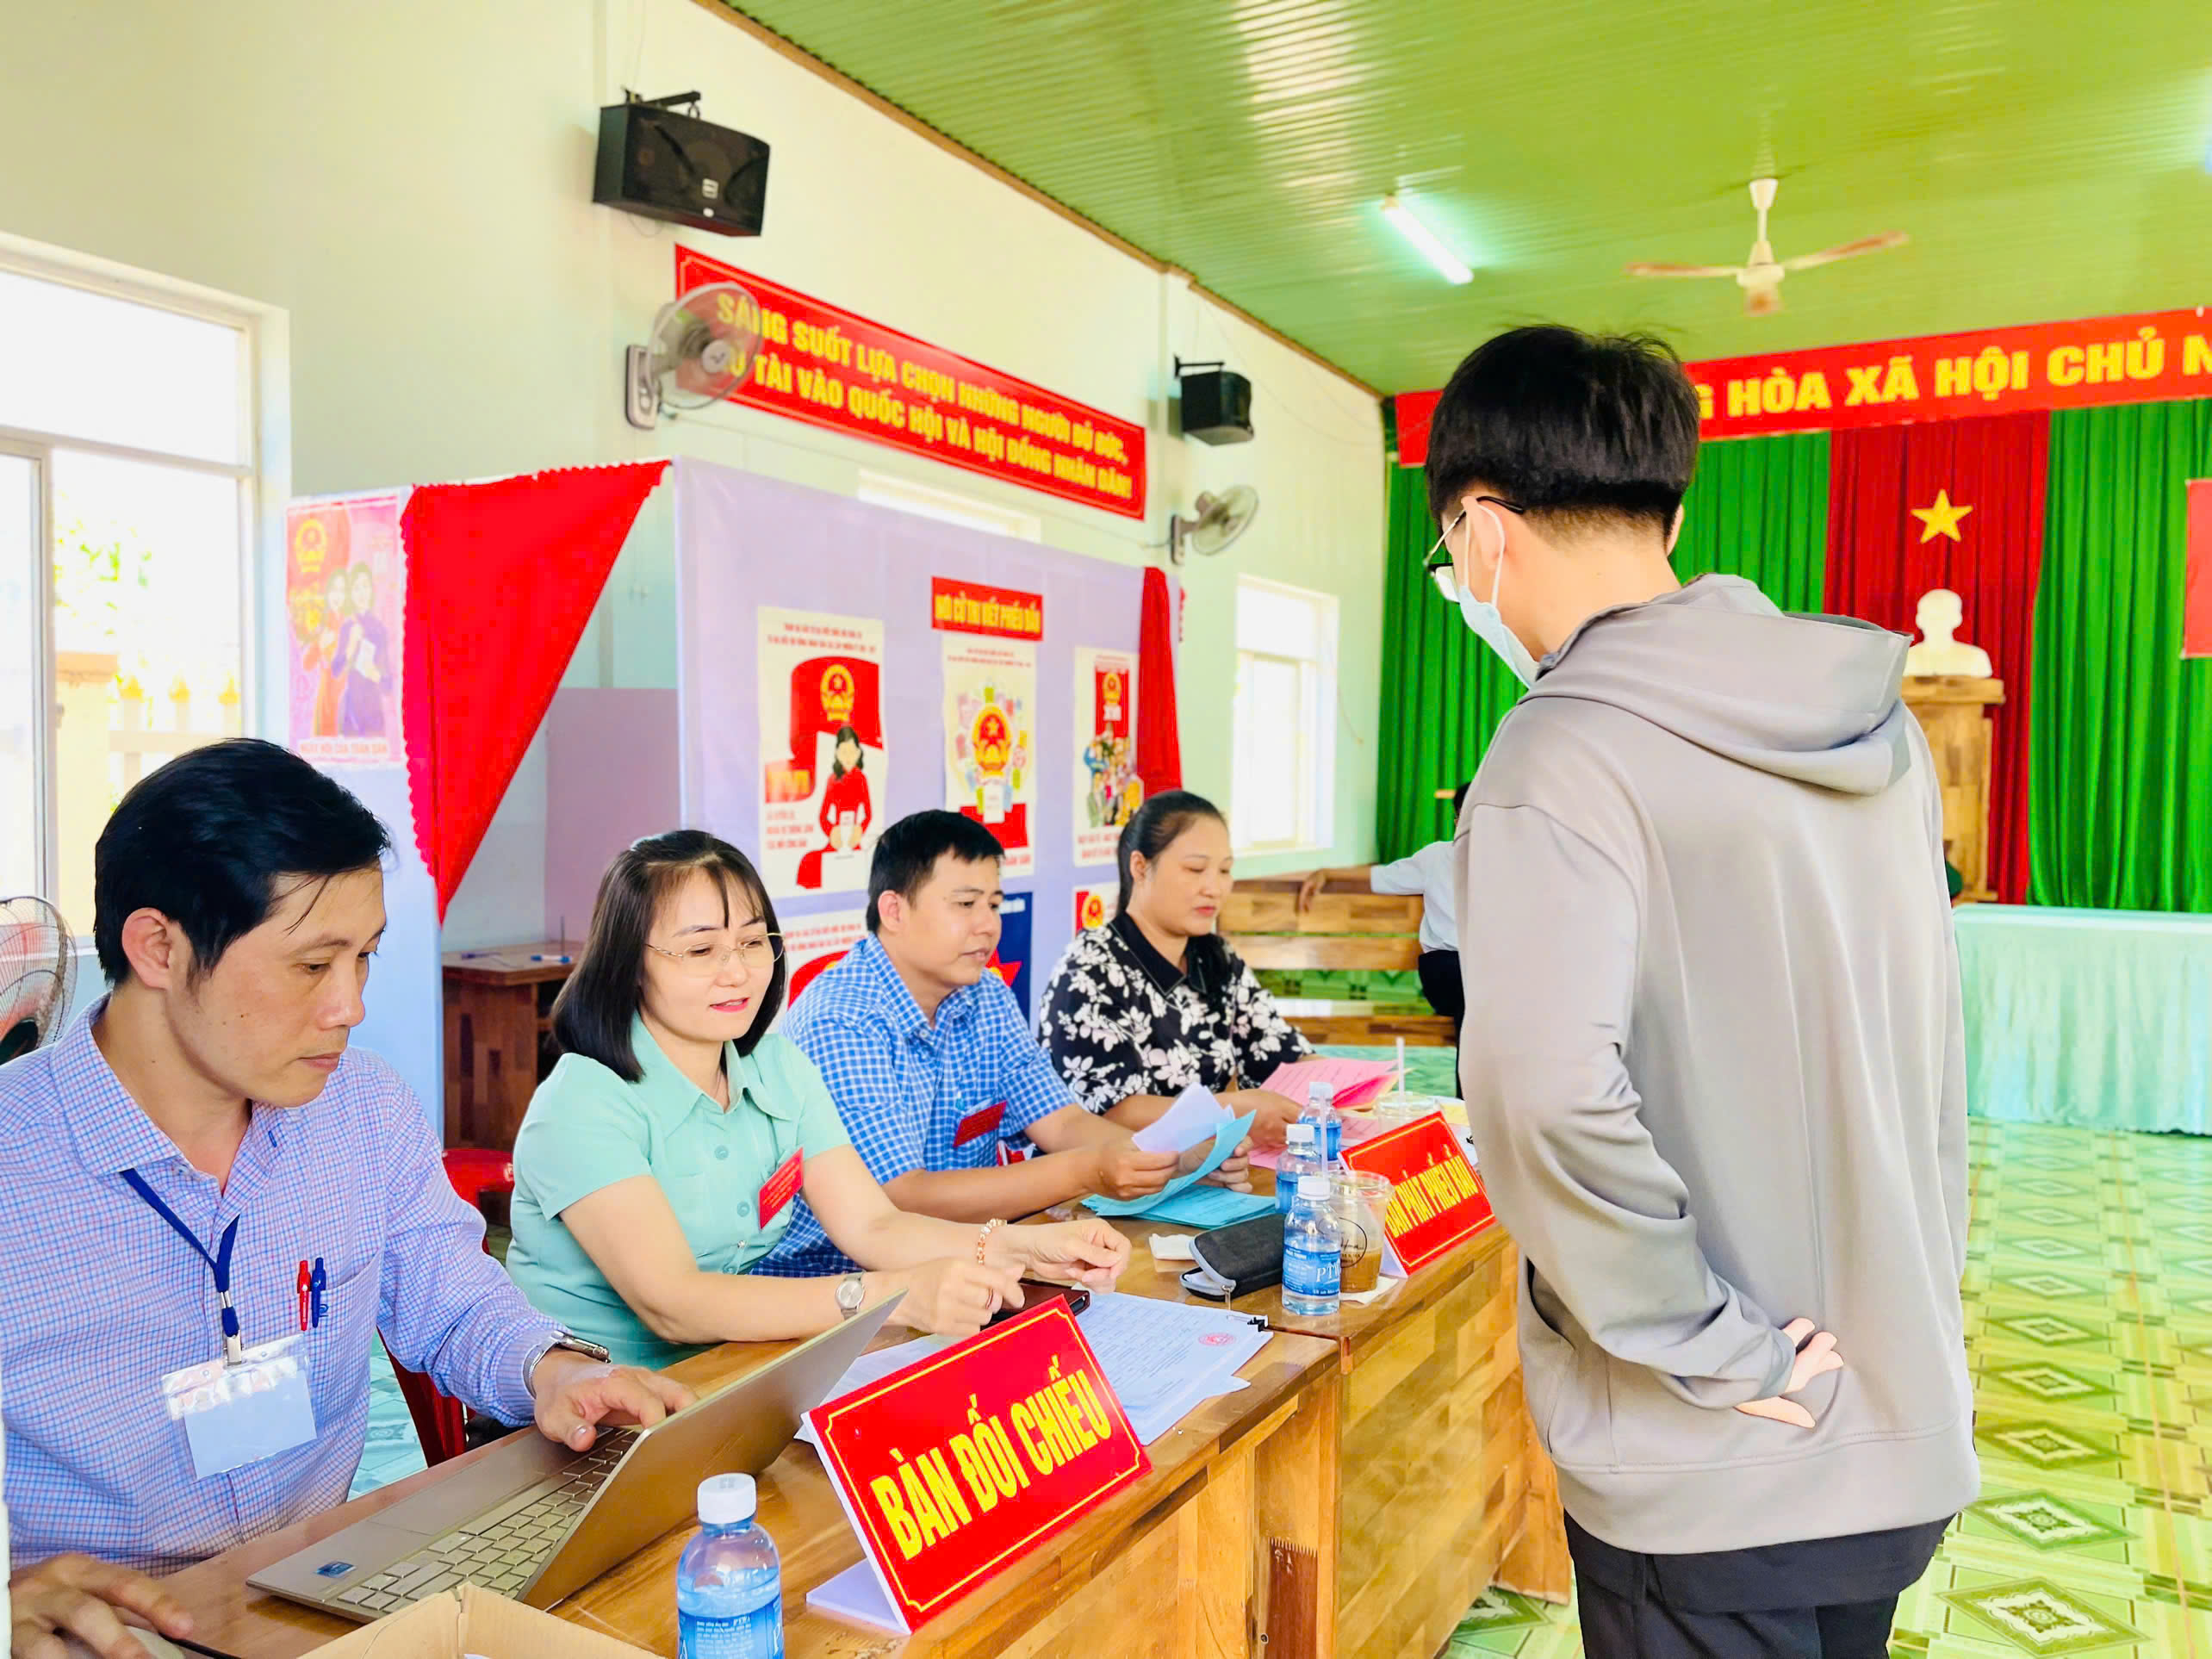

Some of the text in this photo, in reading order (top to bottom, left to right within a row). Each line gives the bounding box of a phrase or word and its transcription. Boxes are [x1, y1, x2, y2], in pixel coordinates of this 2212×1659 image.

[754, 352, 793, 393] TÀI
[797, 368, 845, 409] VÀO
[848, 386, 905, 429] QUỐC
[908, 405, 944, 444] HỘI
[945, 415, 972, 450] VÀ
[792, 320, 853, 367] SUỐT
[856, 344, 898, 384] LỰA
[901, 359, 956, 404] CHỌN
[1727, 366, 1833, 418] HÒA
[1844, 354, 1920, 407] XÃ
[1935, 345, 2029, 402] HỘI
[2047, 326, 2165, 387] CHỦ
[1395, 1169, 1436, 1227] PHÁT
[1418, 1153, 1462, 1213] PHIẾU
[869, 1353, 1112, 1561] BÀN ĐỐI CHIẾU
